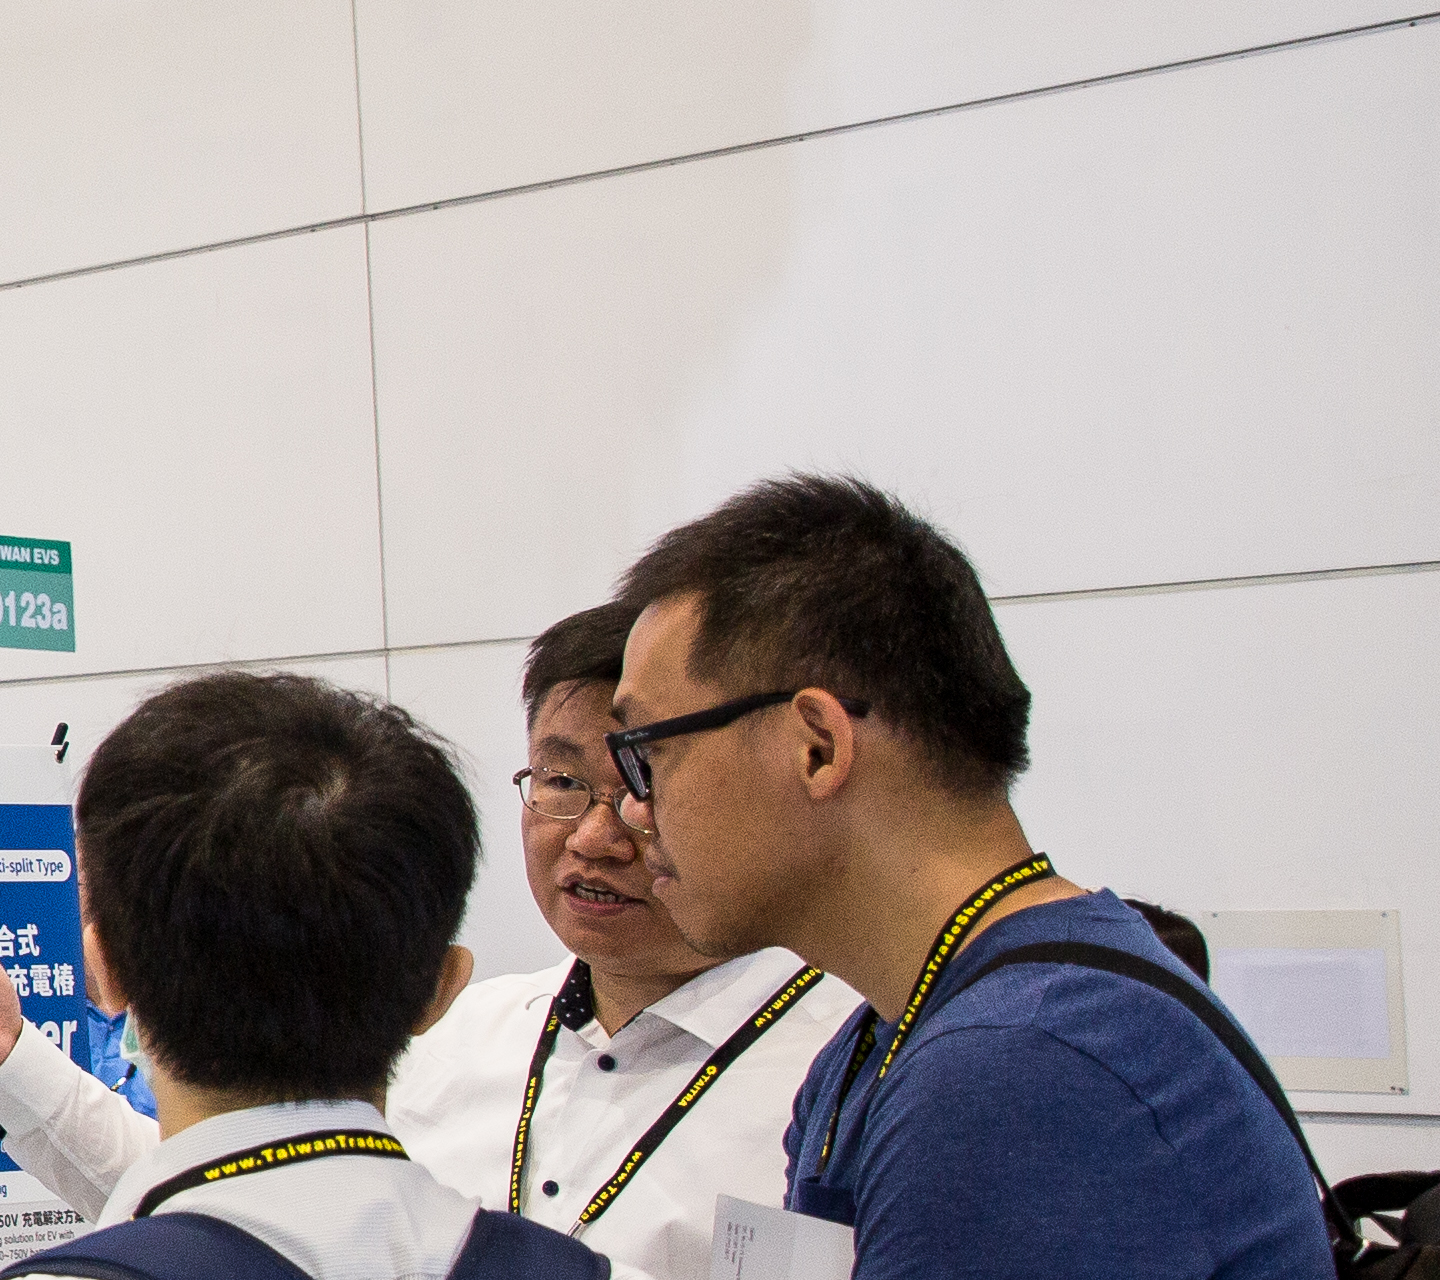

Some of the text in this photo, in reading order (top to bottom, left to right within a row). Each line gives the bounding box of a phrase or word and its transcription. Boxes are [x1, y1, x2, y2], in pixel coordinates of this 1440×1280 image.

[33, 548, 60, 566] EVS
[35, 859, 64, 877] Type
[4, 1232, 34, 1244] solution
[35, 1232, 46, 1242] for
[47, 1231, 58, 1241] EV
